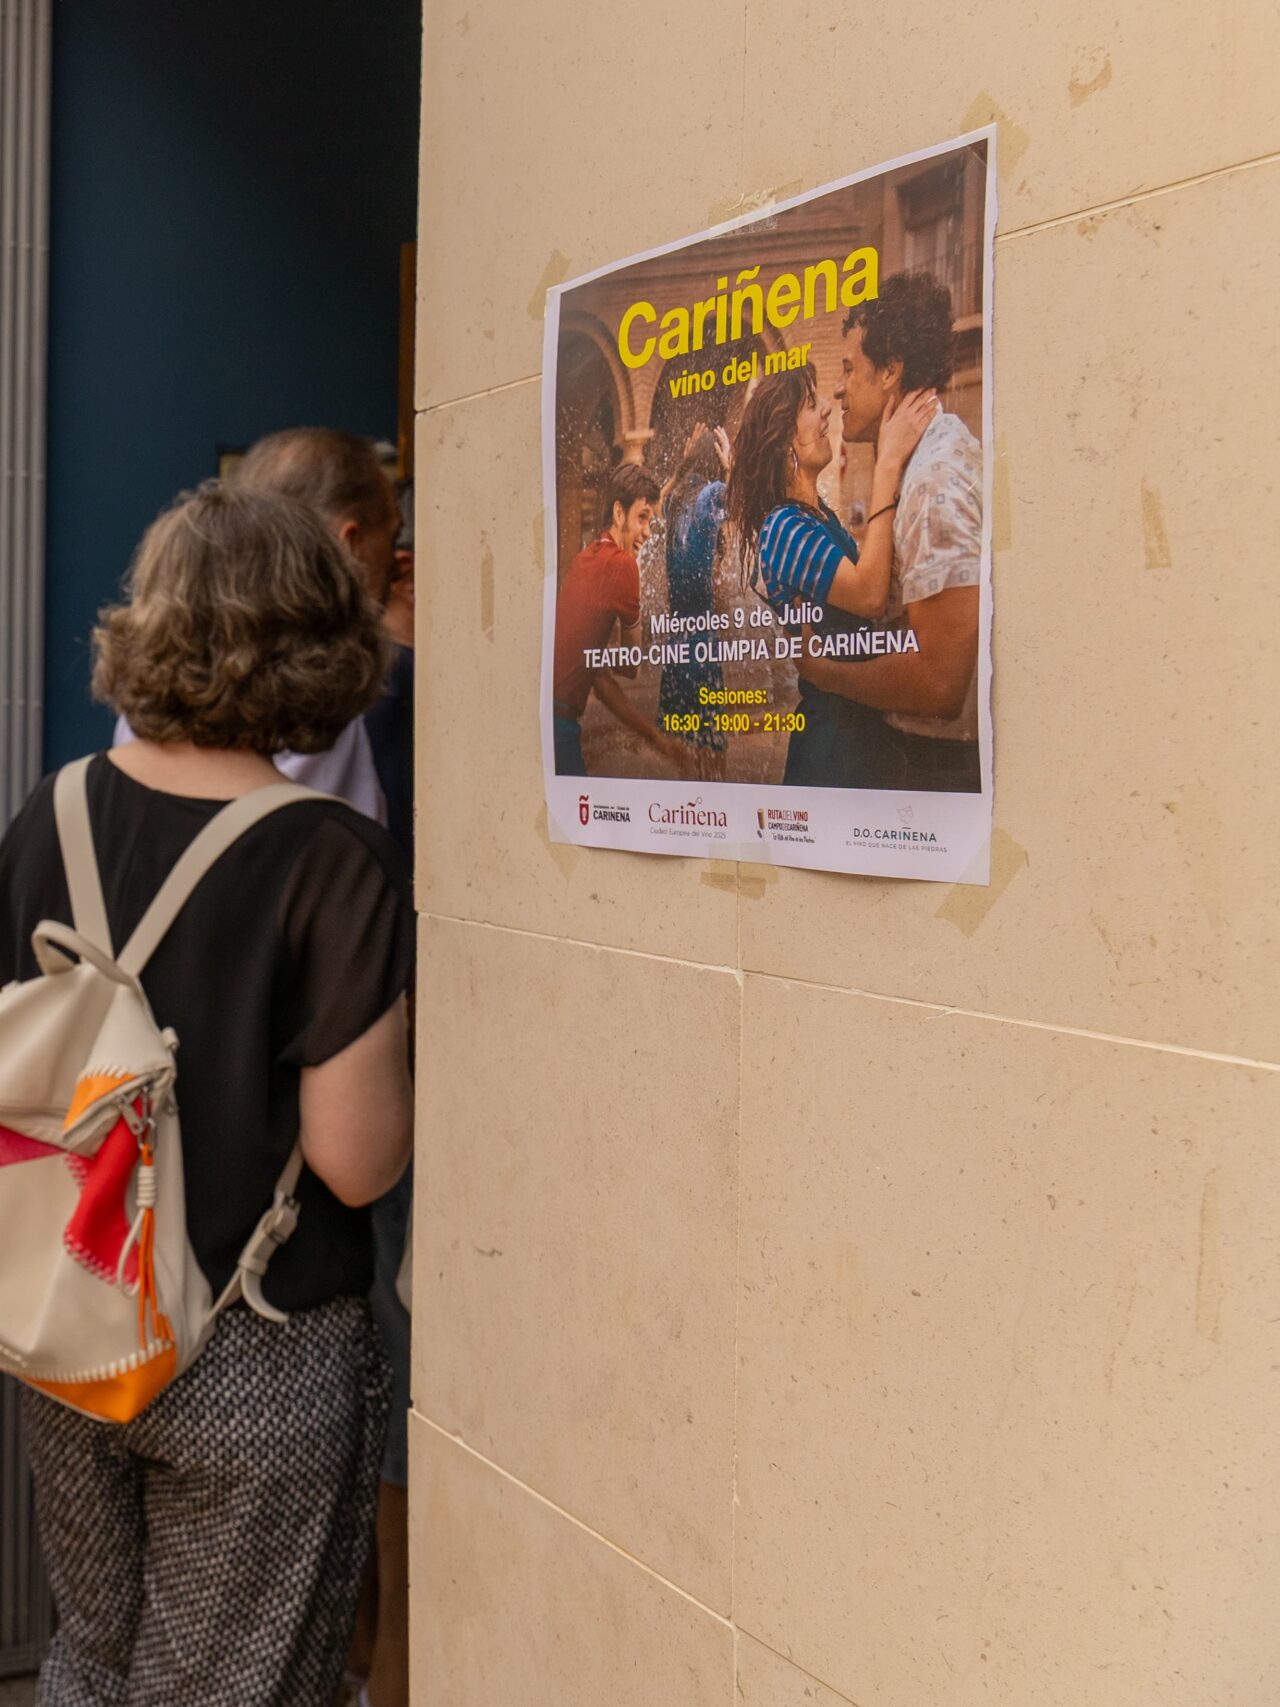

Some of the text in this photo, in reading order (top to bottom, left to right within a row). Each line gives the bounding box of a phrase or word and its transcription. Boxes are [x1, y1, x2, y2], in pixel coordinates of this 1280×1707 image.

[618, 246, 879, 370] Cariñena
[669, 342, 812, 399] vino del mar
[650, 603, 824, 635] Miércoles 9 de Julio
[583, 627, 920, 668] TEATRO-CINE OLIMPIA DE CARIÑENA
[699, 687, 768, 705] Sesiones:
[663, 714, 700, 732] 16:30
[713, 714, 750, 732] 19:00
[764, 712, 805, 732] 21:30
[648, 800, 727, 827] Cariñena
[853, 828, 872, 839] D.O.
